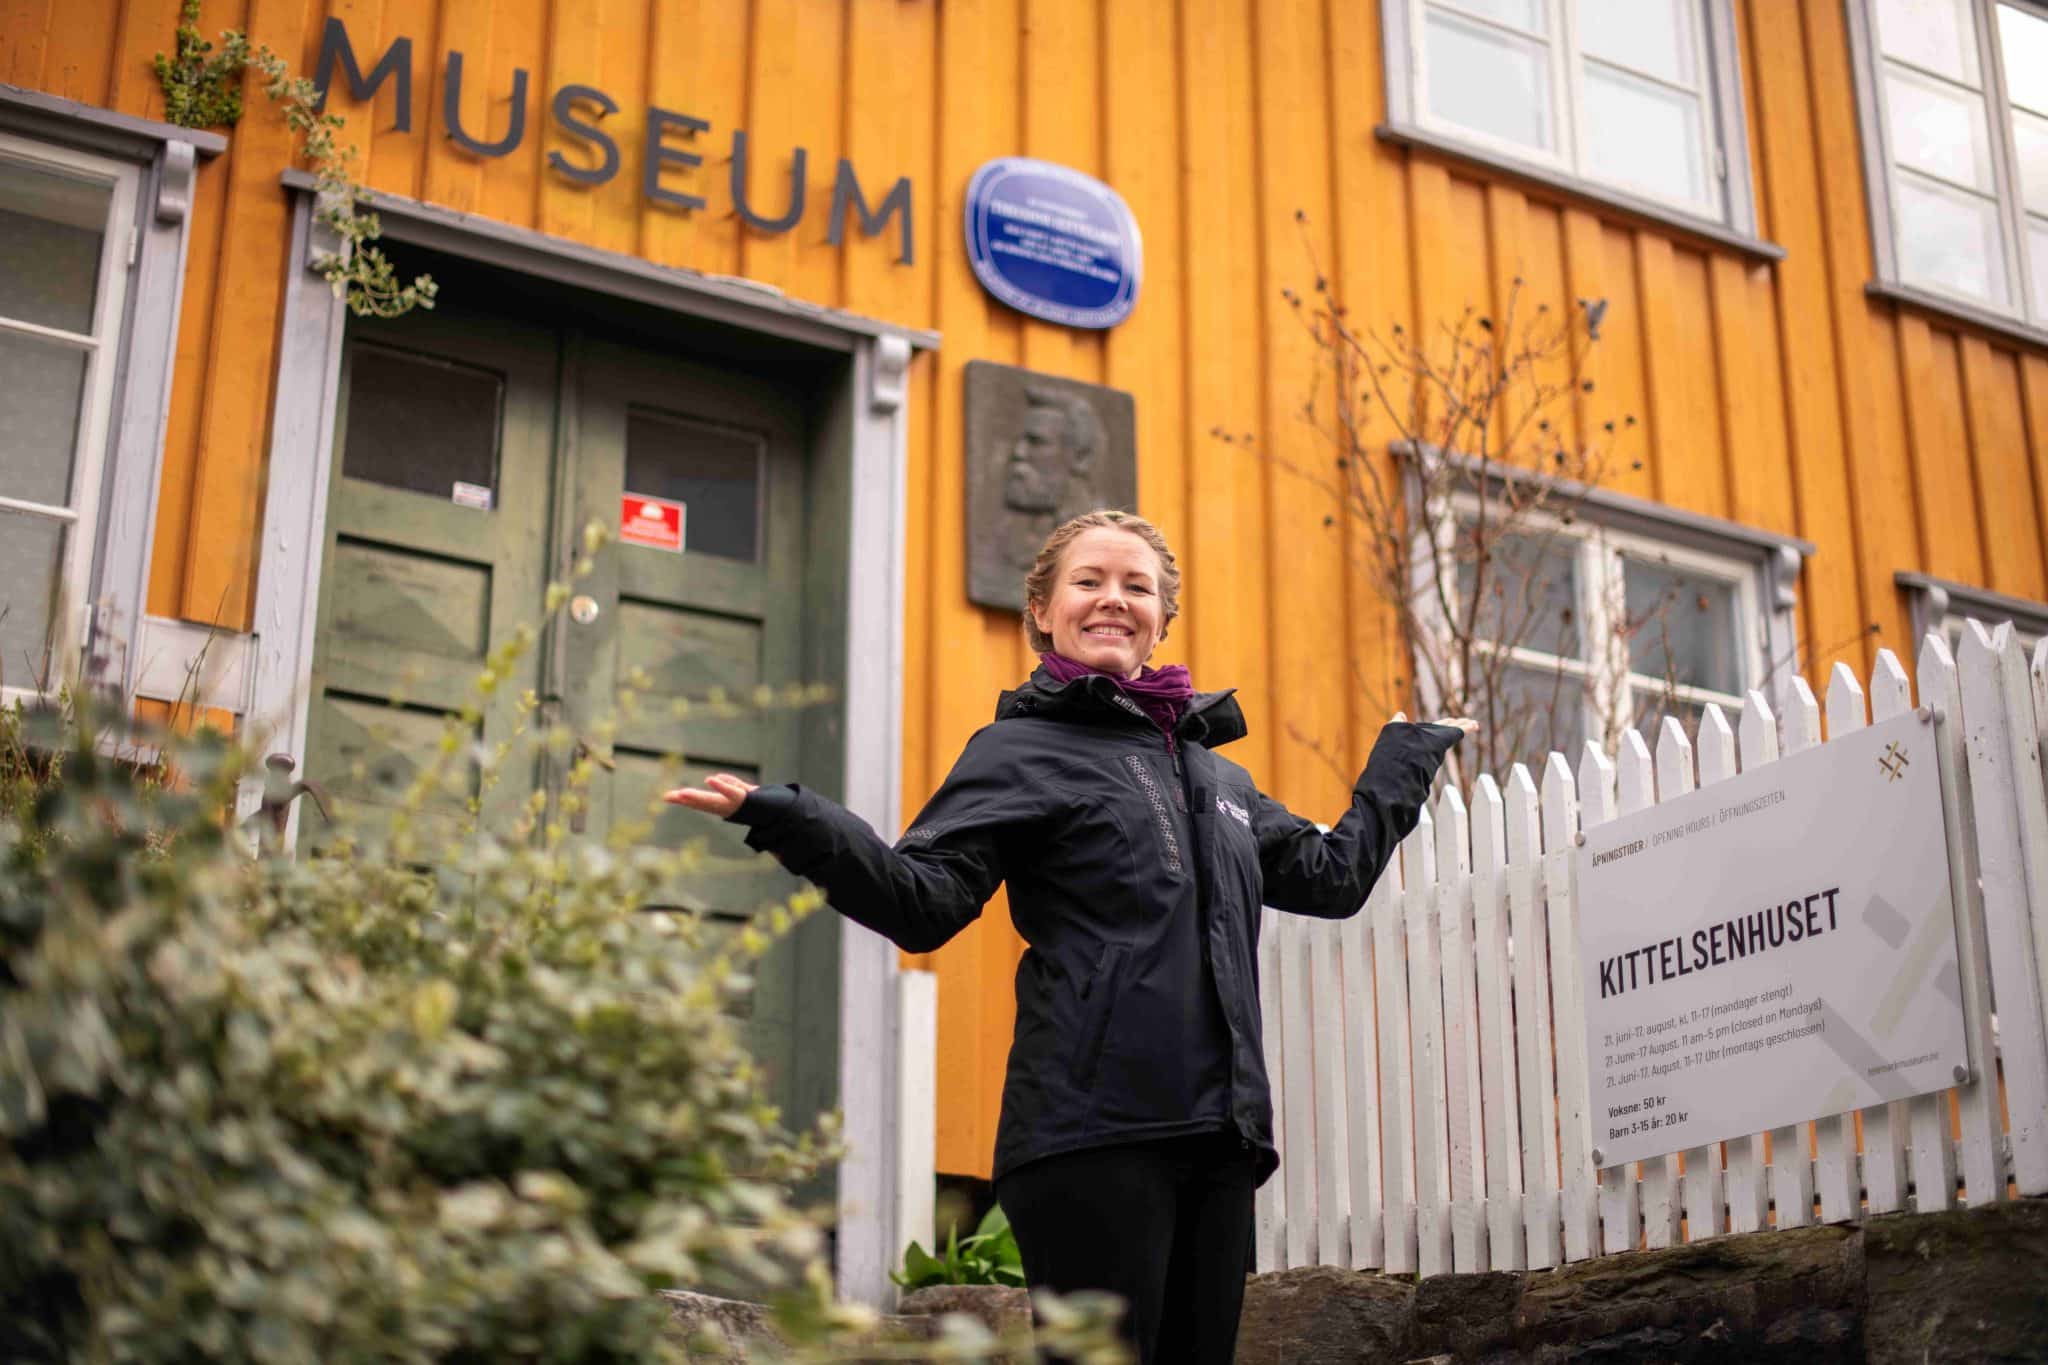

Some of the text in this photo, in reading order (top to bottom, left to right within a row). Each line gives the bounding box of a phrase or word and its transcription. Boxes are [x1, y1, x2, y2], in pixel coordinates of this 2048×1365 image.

[316, 15, 914, 267] MUSEUM
[1592, 839, 1644, 868] ÅPNINGSTIDER
[1652, 825, 1684, 848] OPENING
[1685, 815, 1711, 836] HOURS
[1599, 887, 1840, 999] KITTELSENHUSET
[1711, 996, 1758, 1018] (mandager
[1760, 983, 1793, 1003] stengt)
[1715, 1024, 1730, 1040] pm
[1731, 1014, 1763, 1034] (closed
[1765, 1012, 1777, 1024] on
[1779, 997, 1822, 1019] Mondays)
[1705, 1048, 1720, 1062] Uhr
[1722, 1038, 1764, 1059] (montags
[1766, 1018, 1825, 1048] geschlossen)
[1608, 1095, 1666, 1118] Voksne: 50 kr
[1609, 1111, 1689, 1140] Barn 3-15 år: 20 kr
